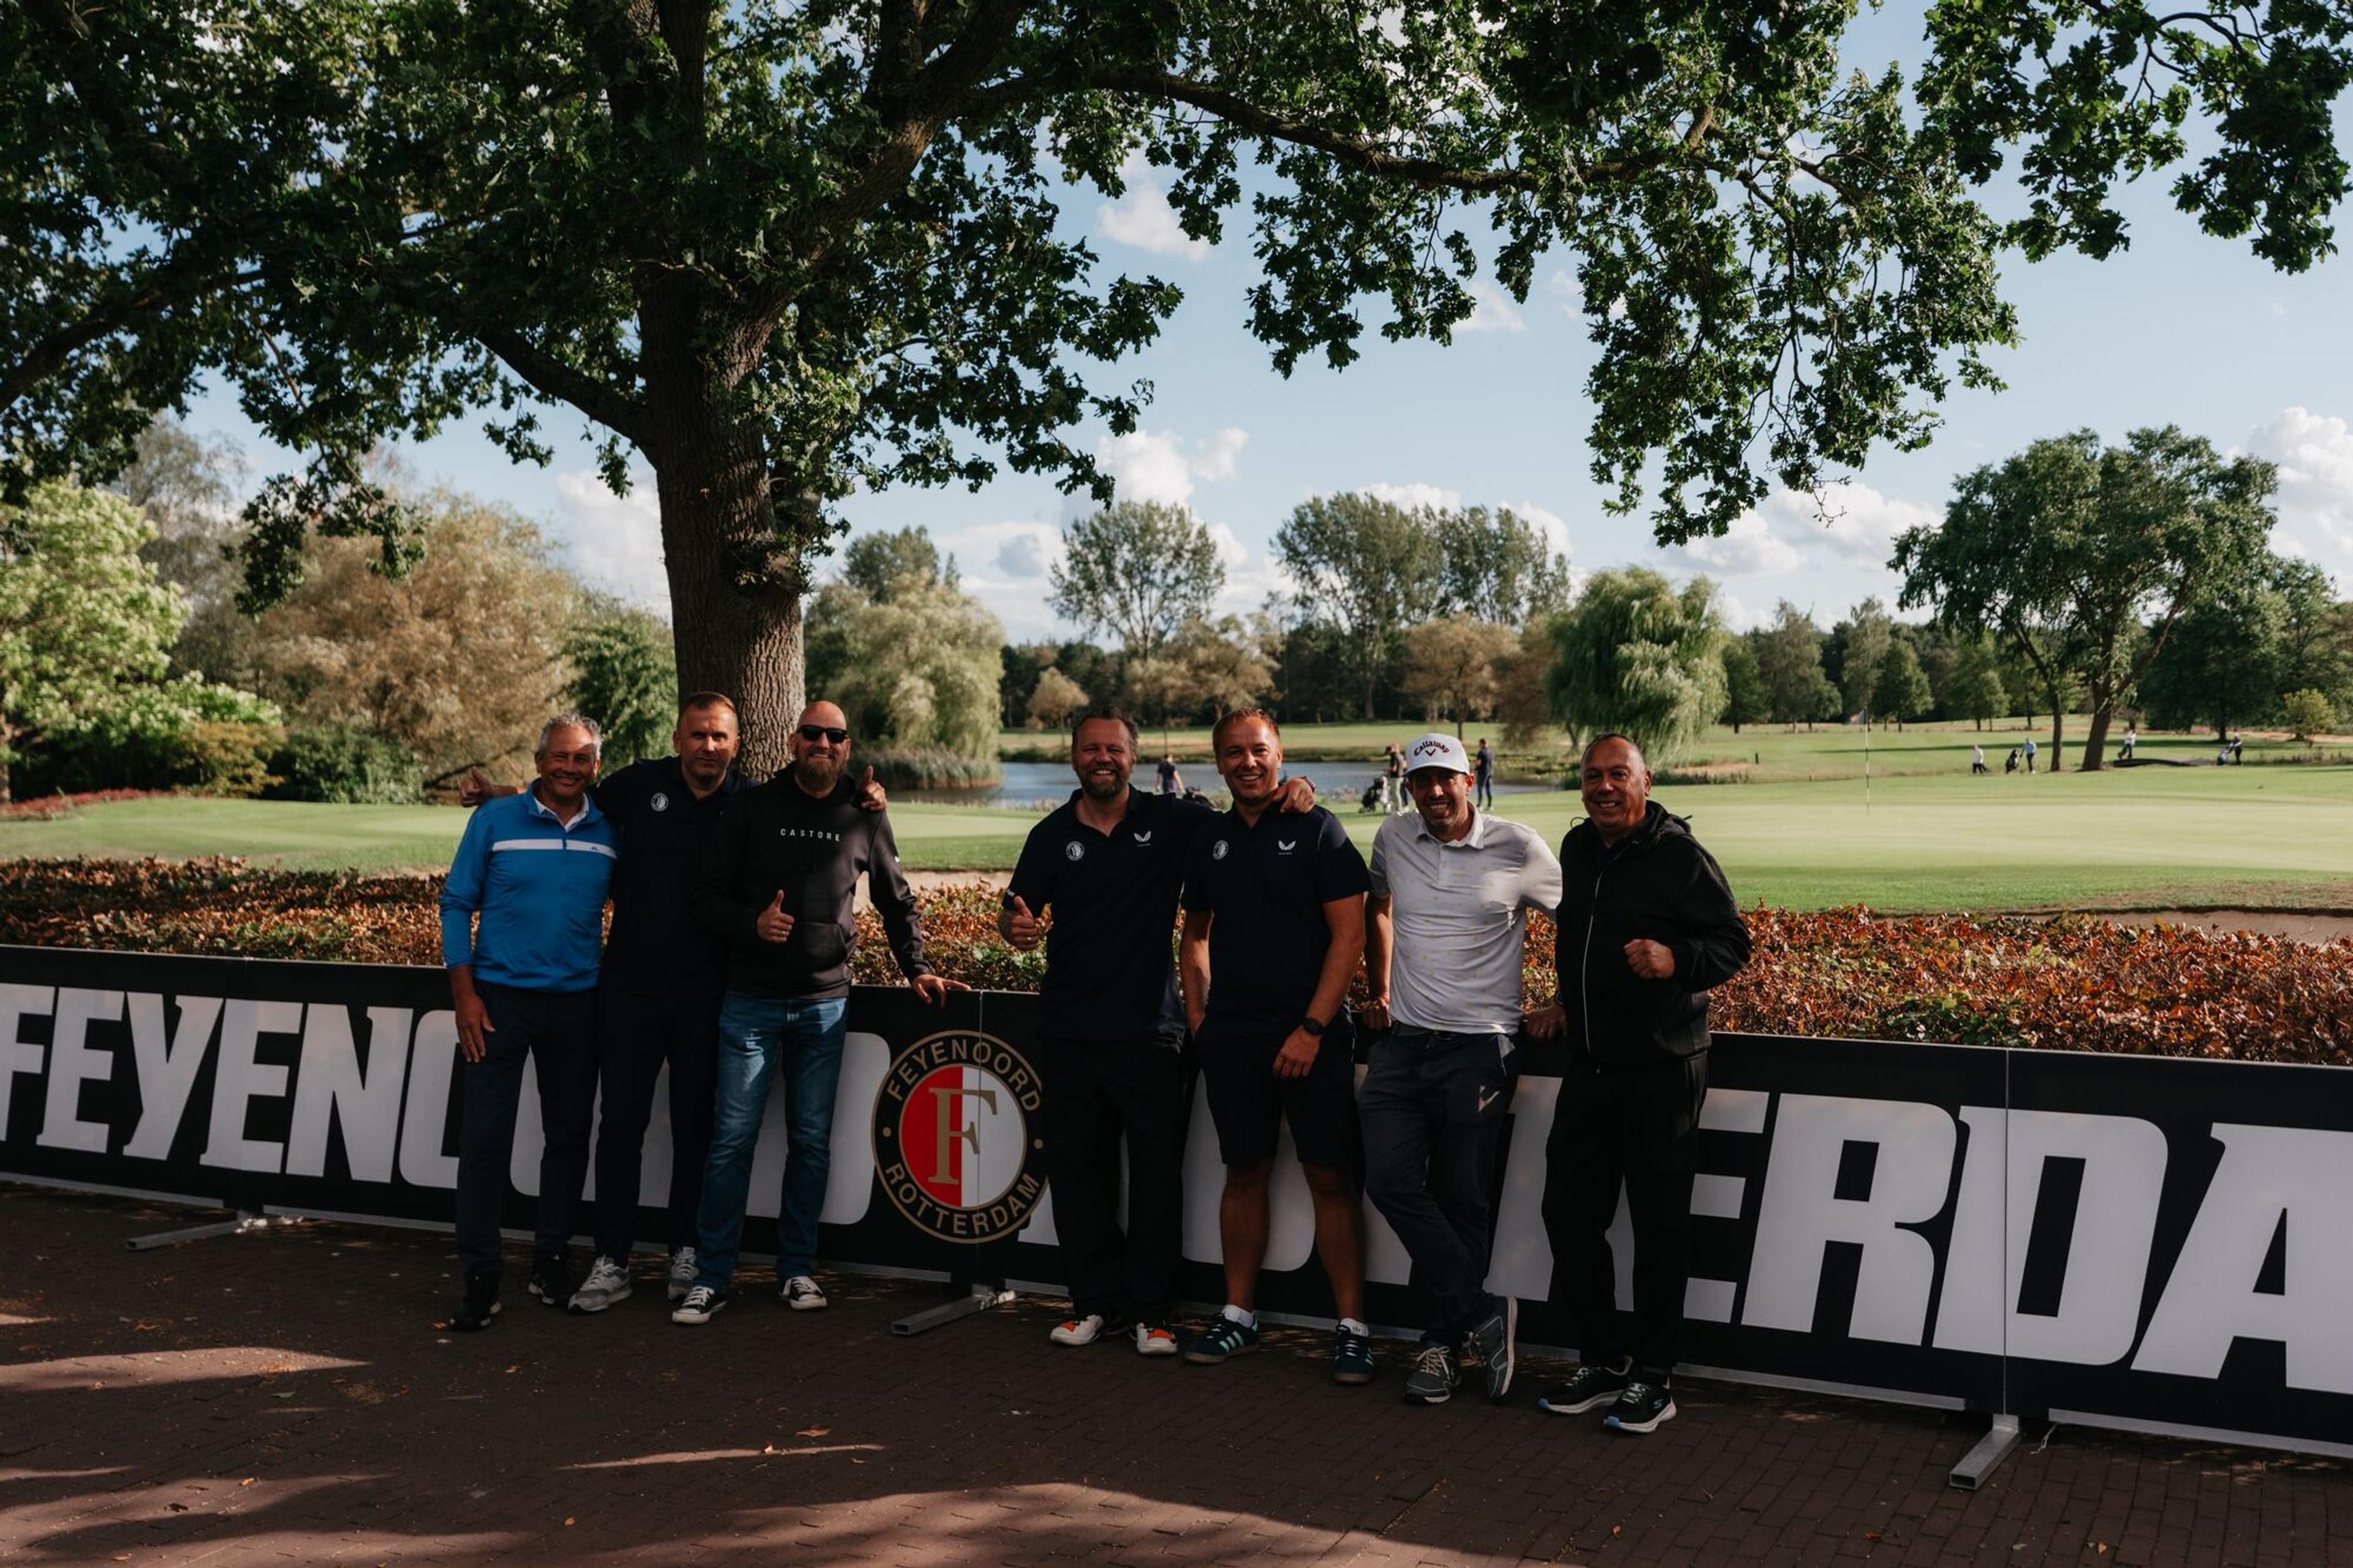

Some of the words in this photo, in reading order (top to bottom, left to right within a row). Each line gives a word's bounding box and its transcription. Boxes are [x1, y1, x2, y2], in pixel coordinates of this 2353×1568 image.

[1414, 740, 1449, 756] Callaway
[780, 828, 840, 842] CASTORE
[888, 1038, 1041, 1112] FEYENOORD
[927, 1087, 998, 1186] F
[885, 1163, 1040, 1235] ROTTERDAM
